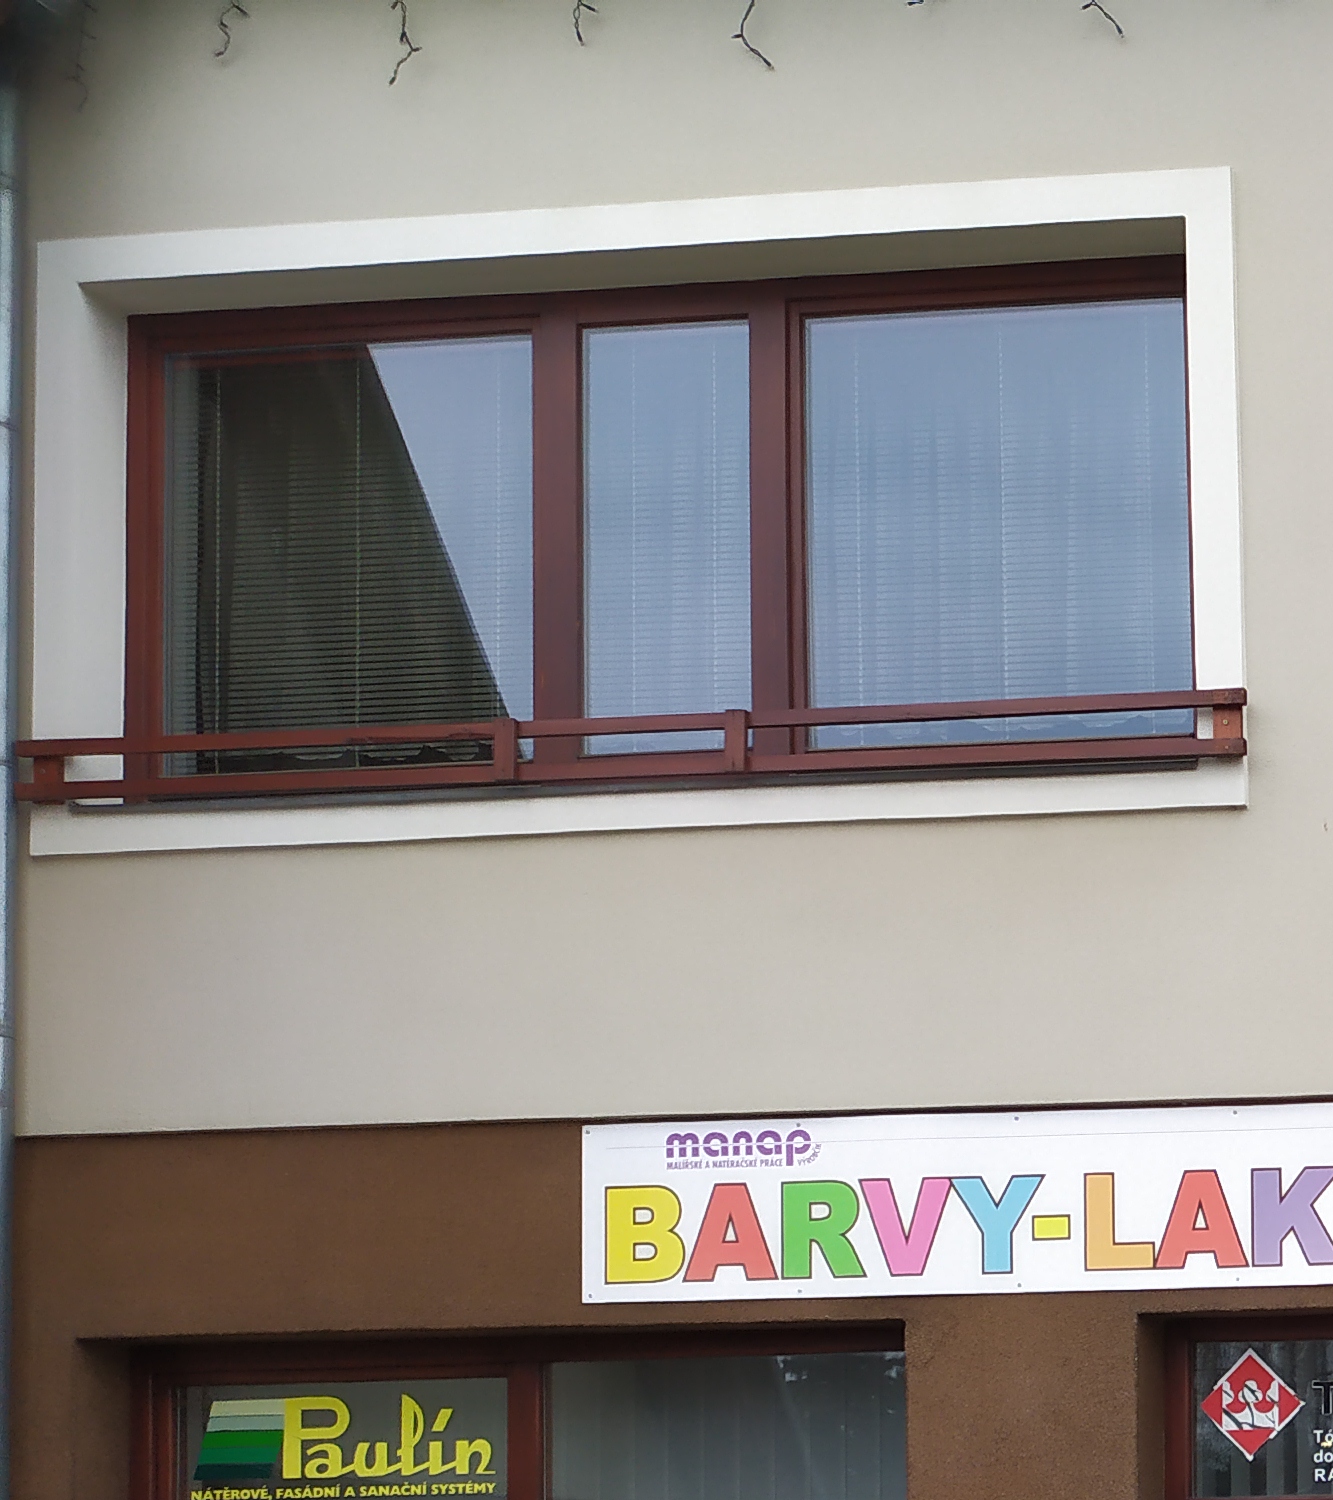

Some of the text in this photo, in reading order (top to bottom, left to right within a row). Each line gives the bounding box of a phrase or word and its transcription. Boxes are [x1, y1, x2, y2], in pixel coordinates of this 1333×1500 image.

[666, 1130, 811, 1166] manap
[705, 1160, 710, 1168] A
[283, 1394, 495, 1479] Paulín
[1313, 1448, 1333, 1463] do
[276, 1483, 339, 1498] FASÁDNÍ
[344, 1487, 355, 1497] A
[359, 1481, 426, 1496] SANAČNÍ
[431, 1480, 495, 1495] SYSTÉMY
